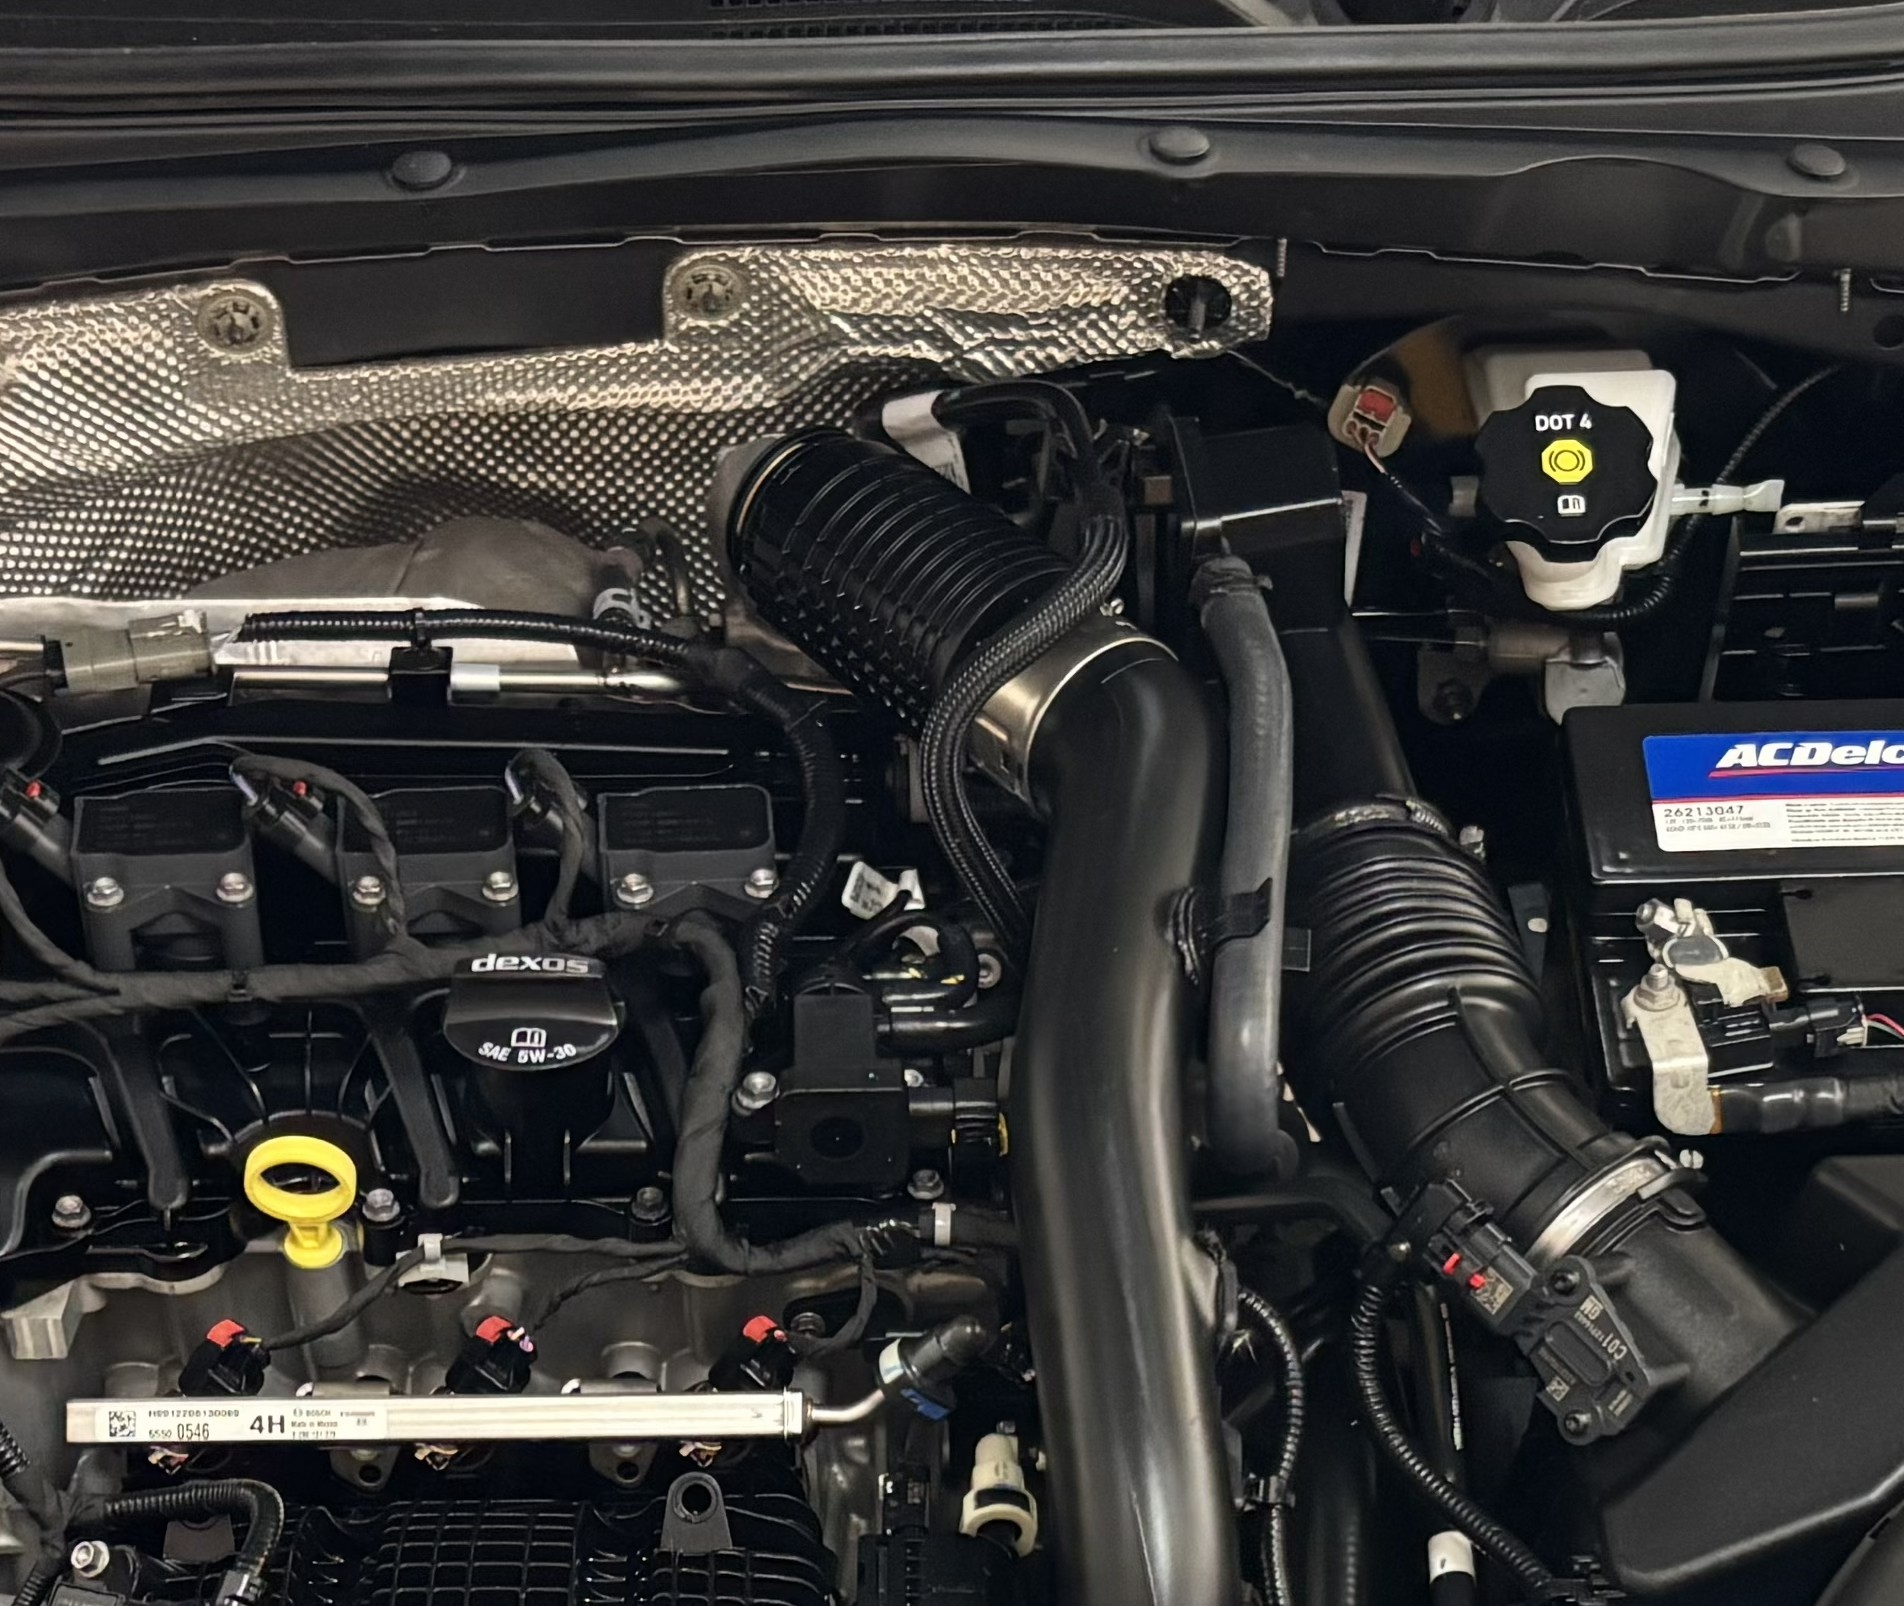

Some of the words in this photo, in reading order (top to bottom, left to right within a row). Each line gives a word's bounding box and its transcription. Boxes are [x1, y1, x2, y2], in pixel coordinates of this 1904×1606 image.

[1535, 414, 1575, 431] DOT
[1579, 413, 1593, 430] 4
[1663, 805, 1744, 818] 26213047
[471, 953, 589, 974] dexos
[478, 1041, 511, 1064] SAE
[516, 1042, 577, 1065] 5W-30
[1580, 1295, 1604, 1320] GM
[177, 1422, 210, 1440] 0546
[249, 1415, 285, 1434] 4H
